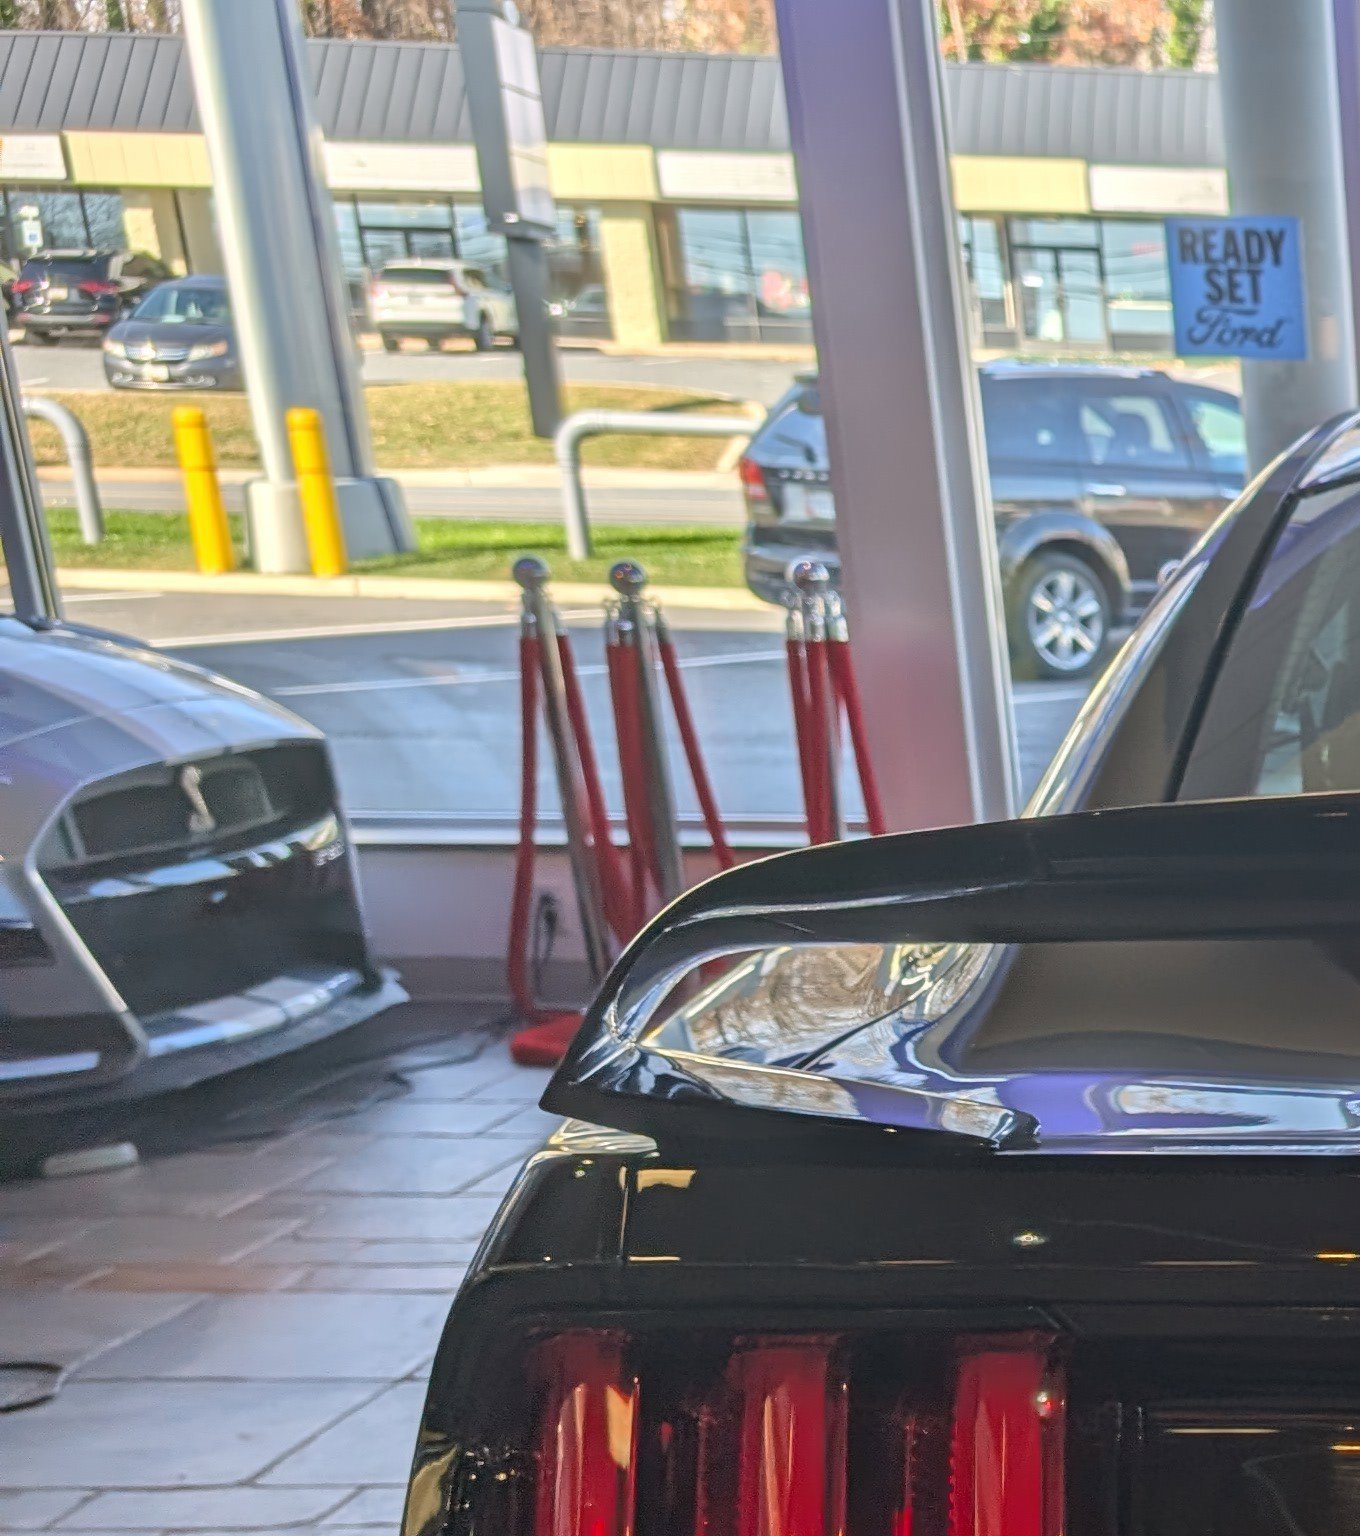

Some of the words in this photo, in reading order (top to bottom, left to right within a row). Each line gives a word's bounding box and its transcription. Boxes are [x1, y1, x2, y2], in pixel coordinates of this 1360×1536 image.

[1178, 228, 1285, 267] READY
[1205, 268, 1262, 305] SET
[1188, 307, 1288, 348] Ford
